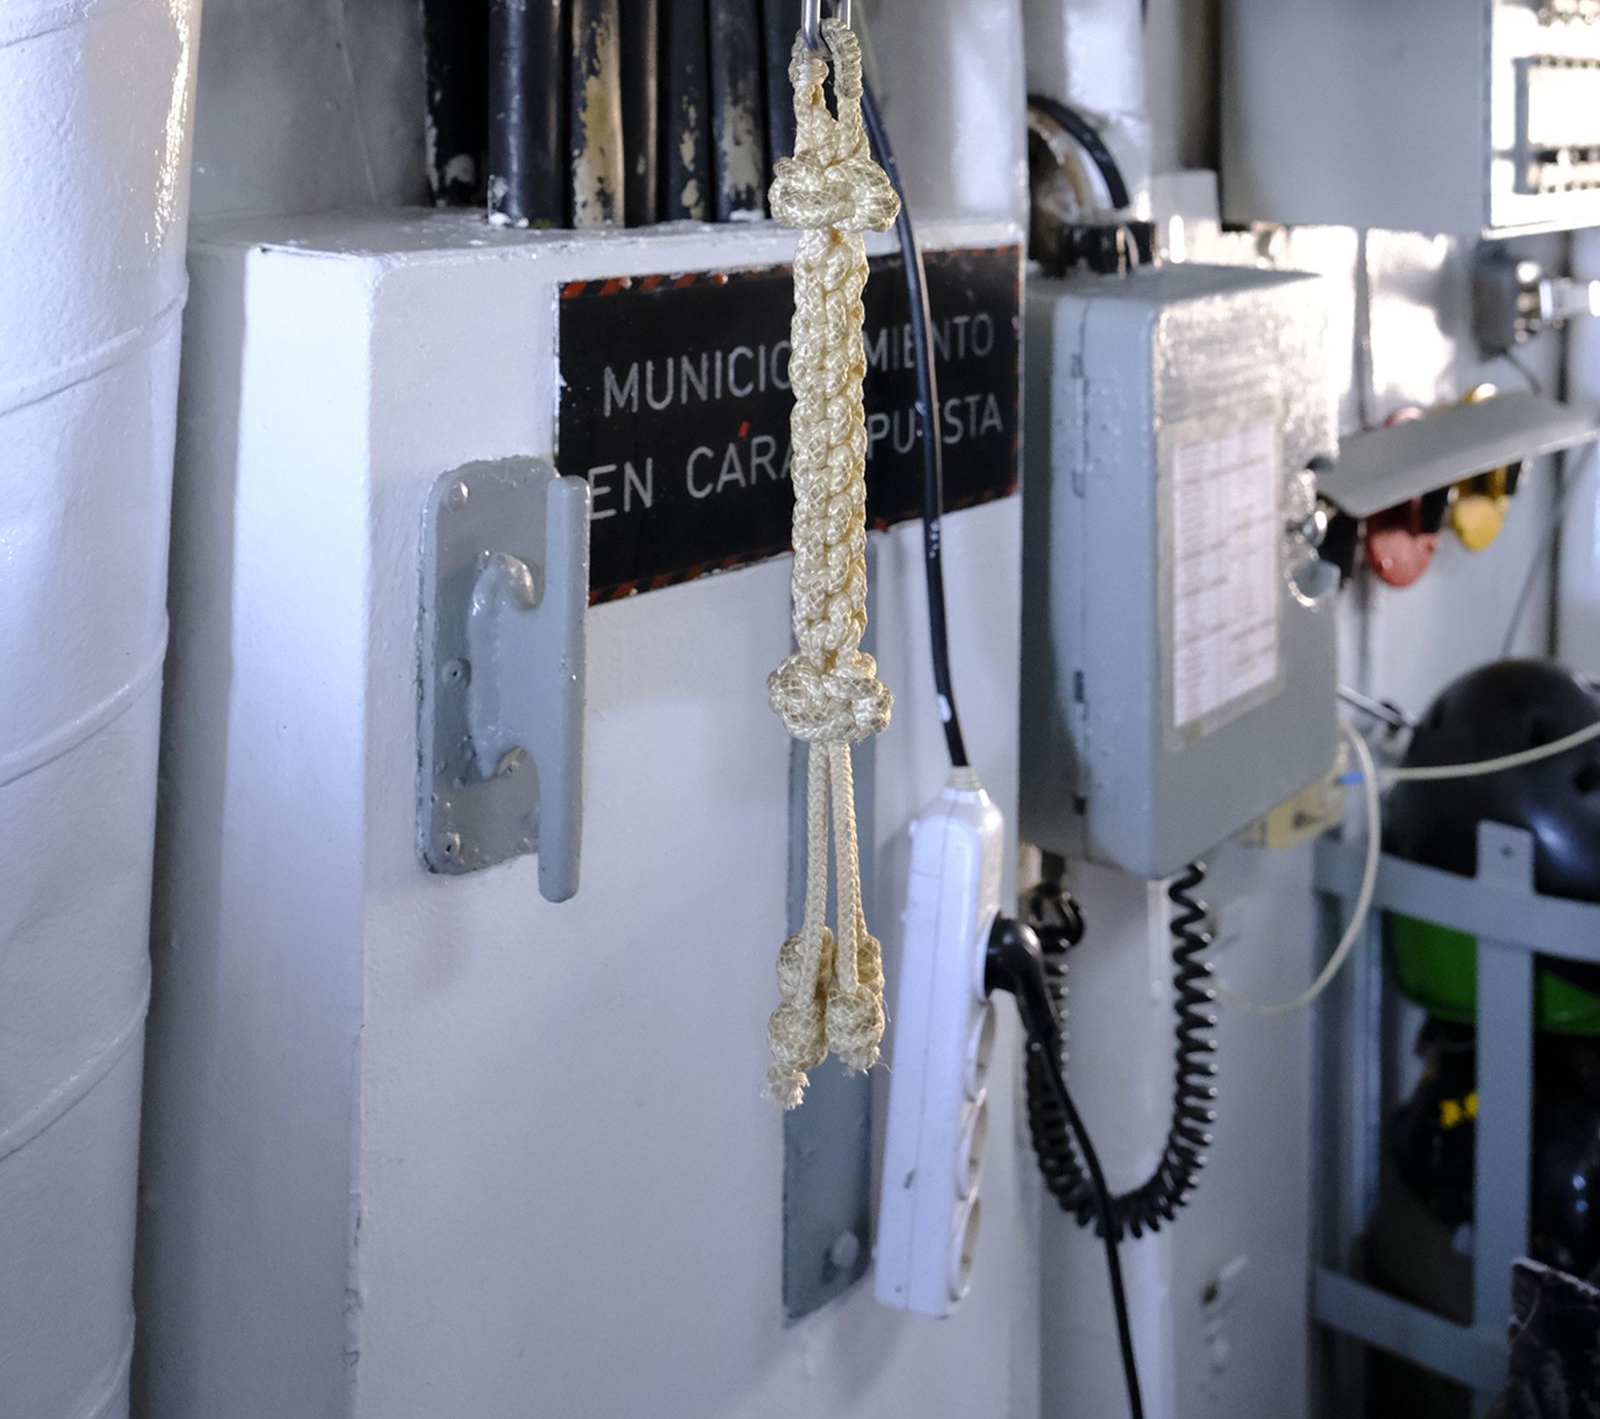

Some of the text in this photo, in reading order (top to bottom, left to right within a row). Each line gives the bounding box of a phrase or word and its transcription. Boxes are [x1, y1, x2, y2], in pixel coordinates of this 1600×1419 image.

[603, 312, 995, 418] MUNICIOMIENTO
[587, 456, 655, 521] EN
[685, 433, 797, 500] CAR
